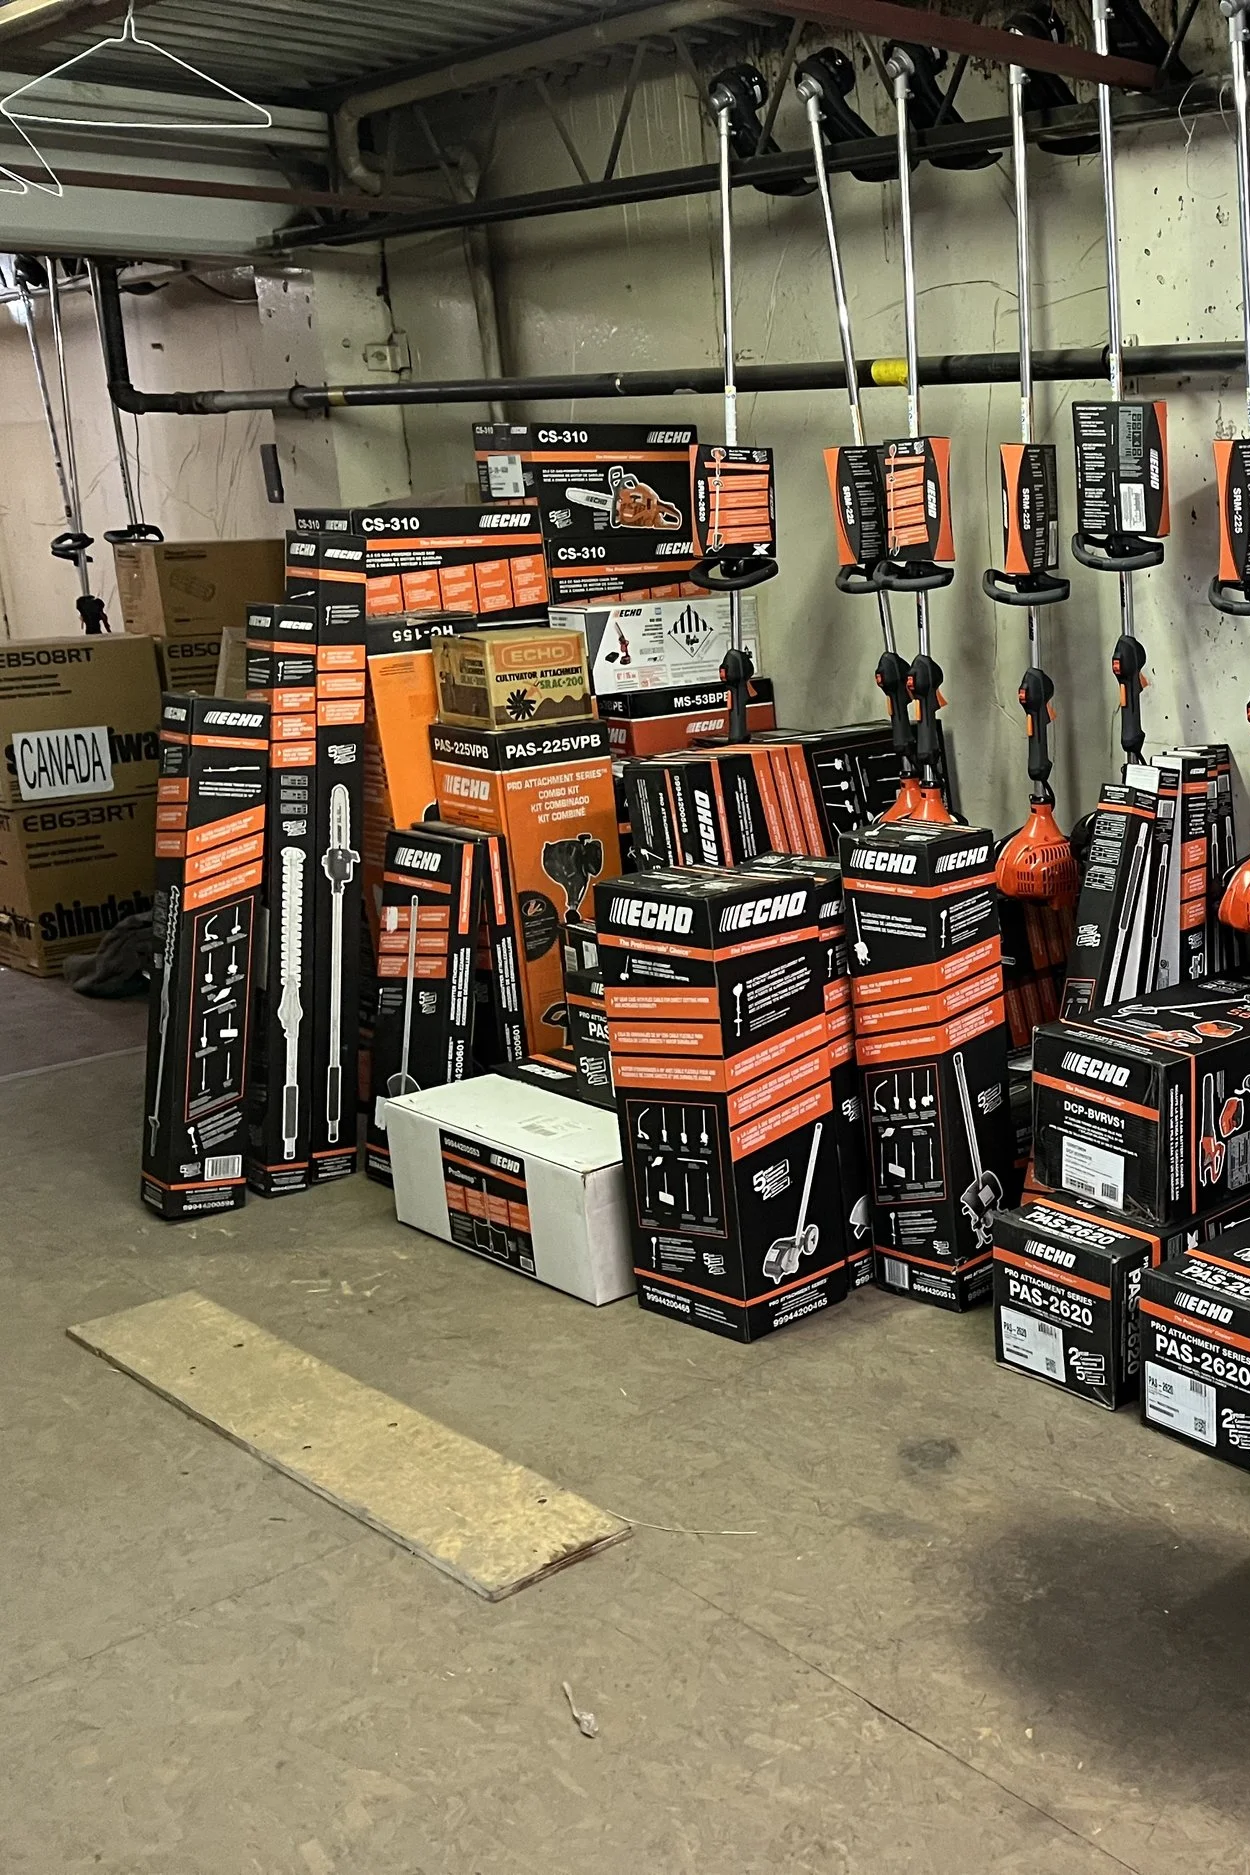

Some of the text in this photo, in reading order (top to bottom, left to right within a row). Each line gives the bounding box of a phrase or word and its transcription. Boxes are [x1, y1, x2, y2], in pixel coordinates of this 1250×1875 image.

[538, 430, 588, 443] CS-310
[647, 431, 692, 444] ECHO
[1150, 448, 1160, 490] ECHO
[927, 480, 938, 519] ECHO
[1022, 487, 1031, 530] SRM-225
[1233, 487, 1243, 534] SRM-225
[298, 519, 320, 530] CS-310
[362, 517, 420, 532] CS-310
[479, 513, 531, 529] ECHO
[557, 546, 606, 561] CS-310
[613, 608, 643, 618] ECHO
[167, 642, 220, 660] EB50
[511, 647, 566, 664] ECHO
[495, 666, 583, 683] CULTIVATOR ATTACHMENT
[203, 710, 264, 728] ECHO
[685, 718, 725, 734] ECHO
[434, 737, 490, 759] PAS-225VPB
[505, 733, 602, 759] PAS-225VPB
[20, 731, 108, 789] CANADA
[444, 774, 491, 801] ECHO
[506, 781, 523, 791] PRO
[524, 773, 574, 789] ATTACHMENT
[538, 784, 580, 800] COMBO KIT
[22, 801, 138, 833] EB633RT
[530, 795, 590, 813] KIT COMBINADO
[537, 805, 587, 824] KIT COMBINÉ
[692, 789, 719, 866] ECHO
[394, 845, 442, 872] ECHO
[850, 848, 917, 875] ECHO
[935, 845, 989, 875] ECHO
[609, 897, 695, 934] ECHO
[719, 890, 808, 934] ECHO
[1061, 1051, 1132, 1088] ECHO
[1064, 1100, 1125, 1130] DCP-BVRVS1
[489, 1153, 521, 1174] ECHO
[1026, 1211, 1116, 1246] PAS-2620
[1024, 1239, 1077, 1269] ECHO
[1004, 1266, 1019, 1280] PRO
[1020, 1272, 1066, 1297] ATTACHMENT
[772, 1297, 829, 1328] 99944200465
[1009, 1278, 1093, 1327] PAS-2620
[1174, 1290, 1234, 1324] ECHO
[1151, 1320, 1167, 1333] PRO
[1168, 1325, 1220, 1354] ATTACHMENT
[1155, 1333, 1250, 1387] PAS-2620
